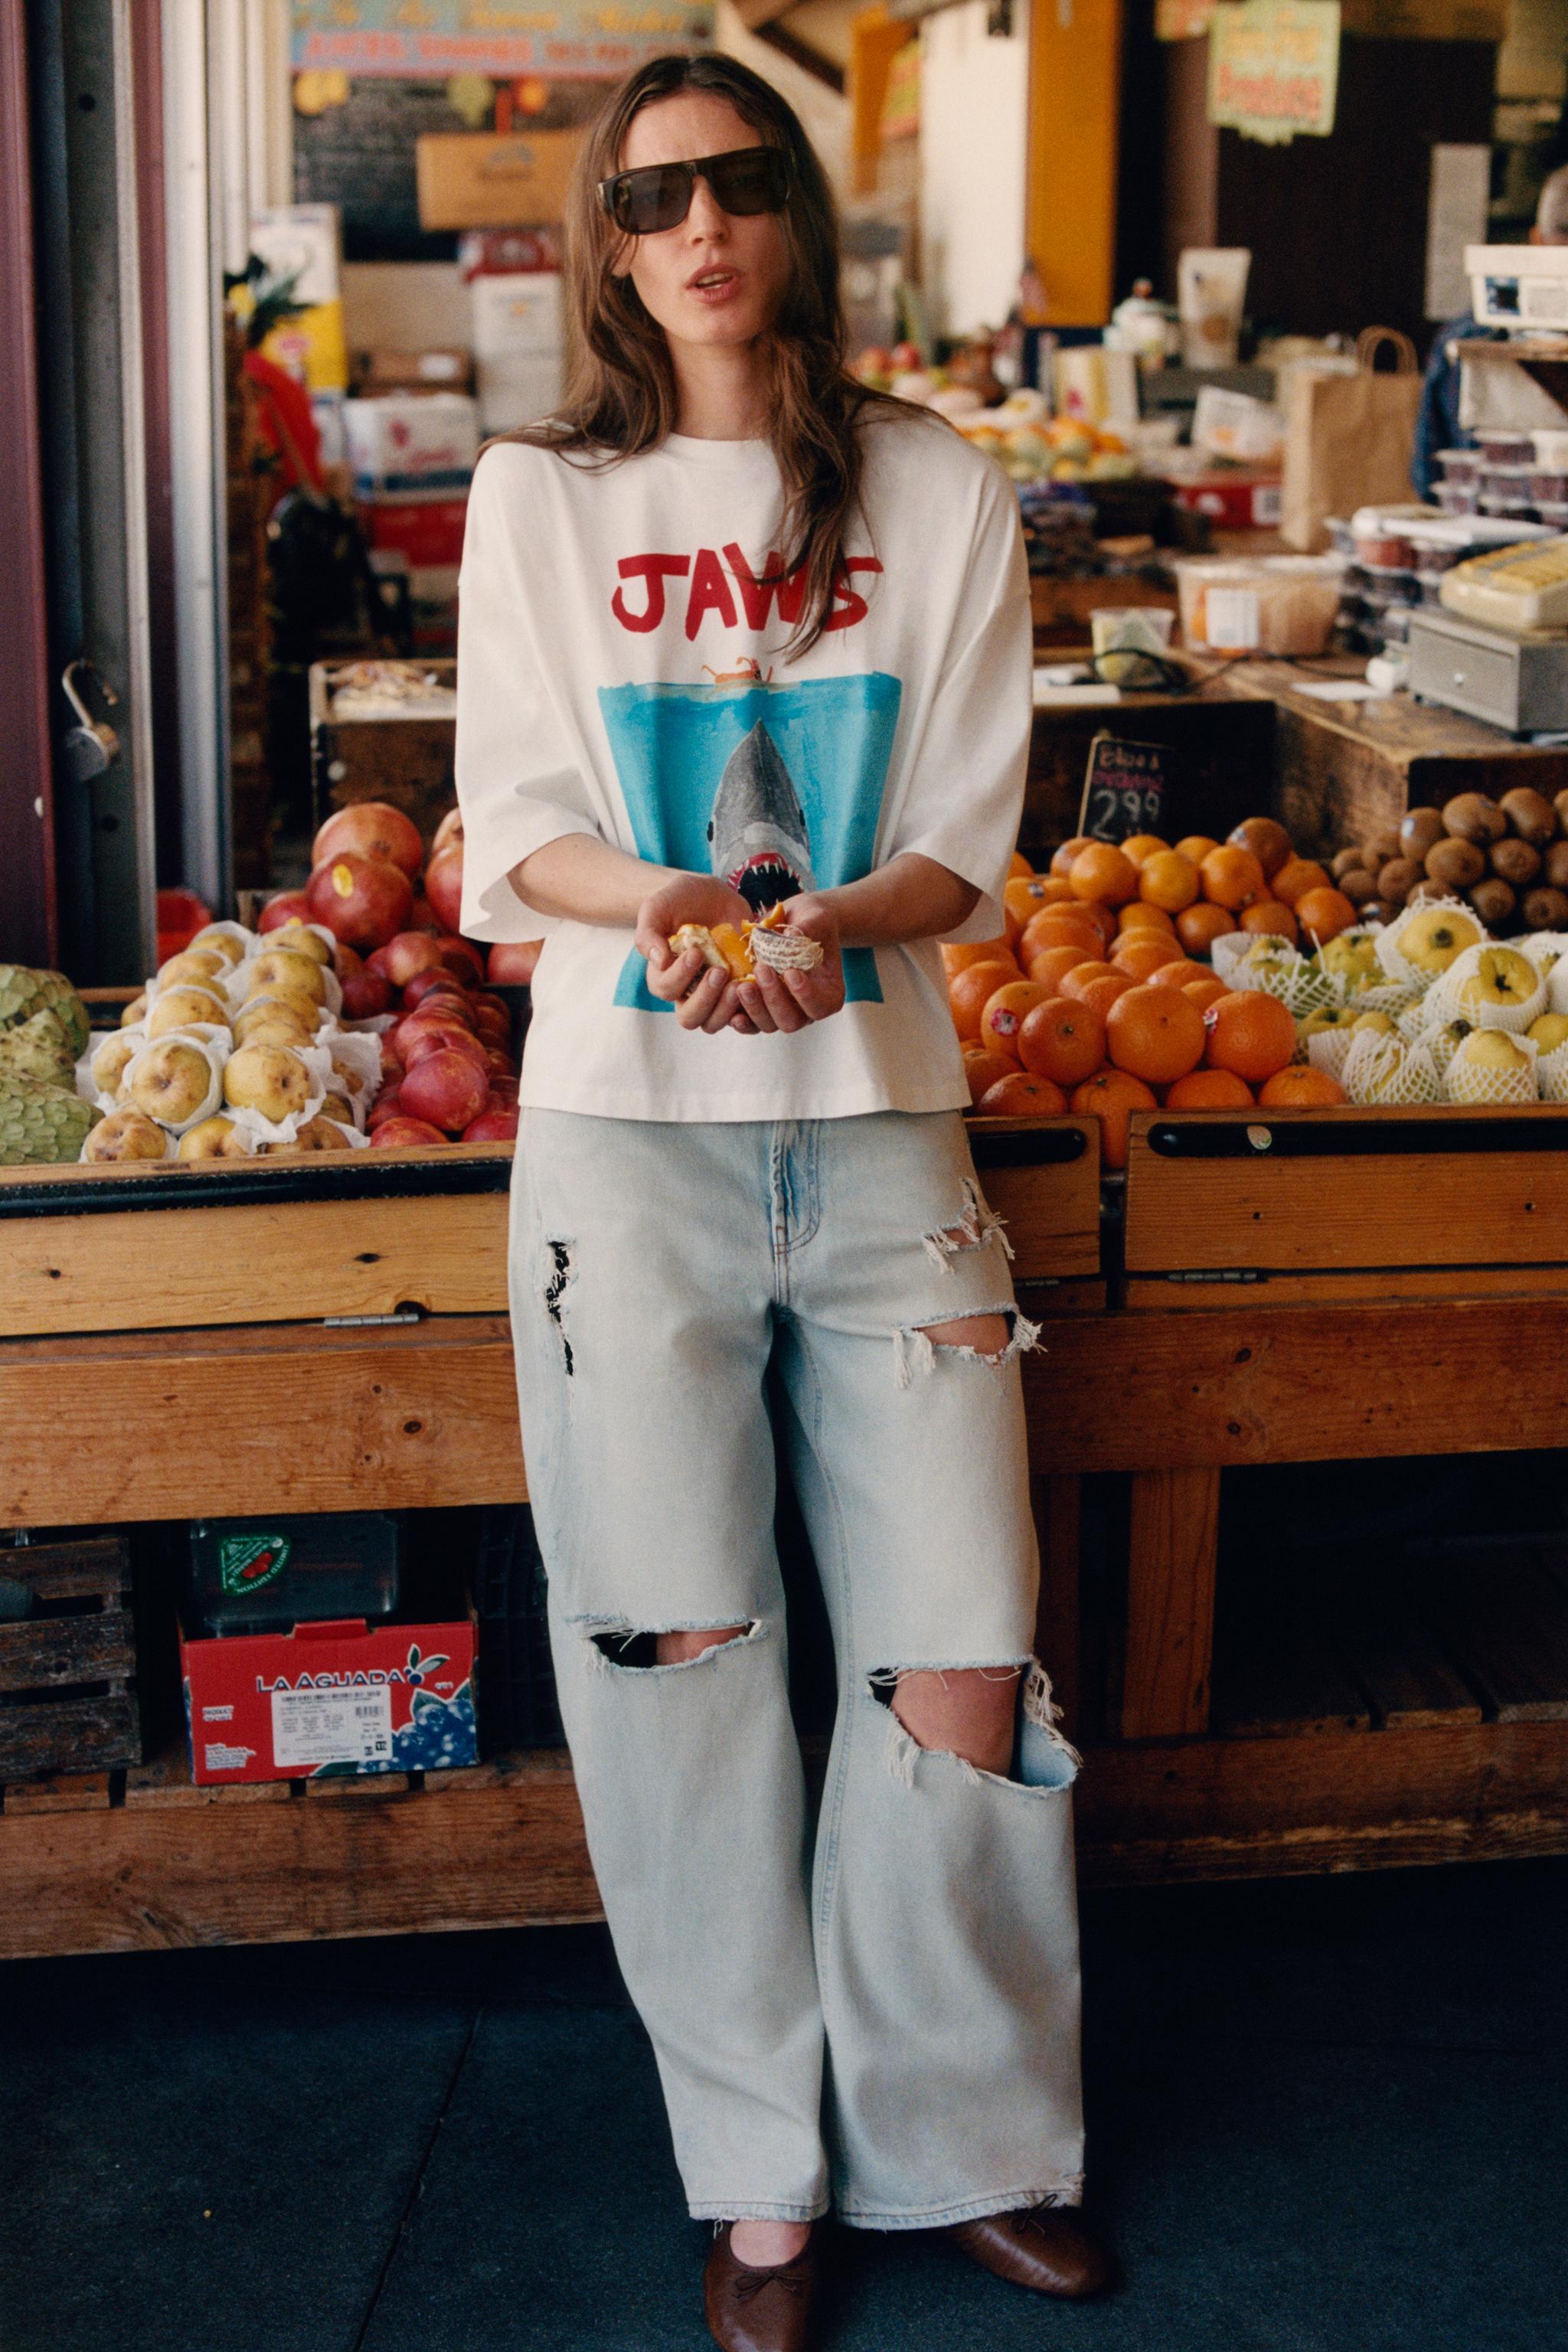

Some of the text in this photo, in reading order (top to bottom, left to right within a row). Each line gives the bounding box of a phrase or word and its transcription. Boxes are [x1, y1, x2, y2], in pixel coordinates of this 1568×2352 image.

[612, 542, 884, 642] JAWS
[270, 1544, 289, 1575] LIMITED
[237, 1573, 272, 1593] EDITION
[256, 1668, 406, 1693] LA AGUADA
